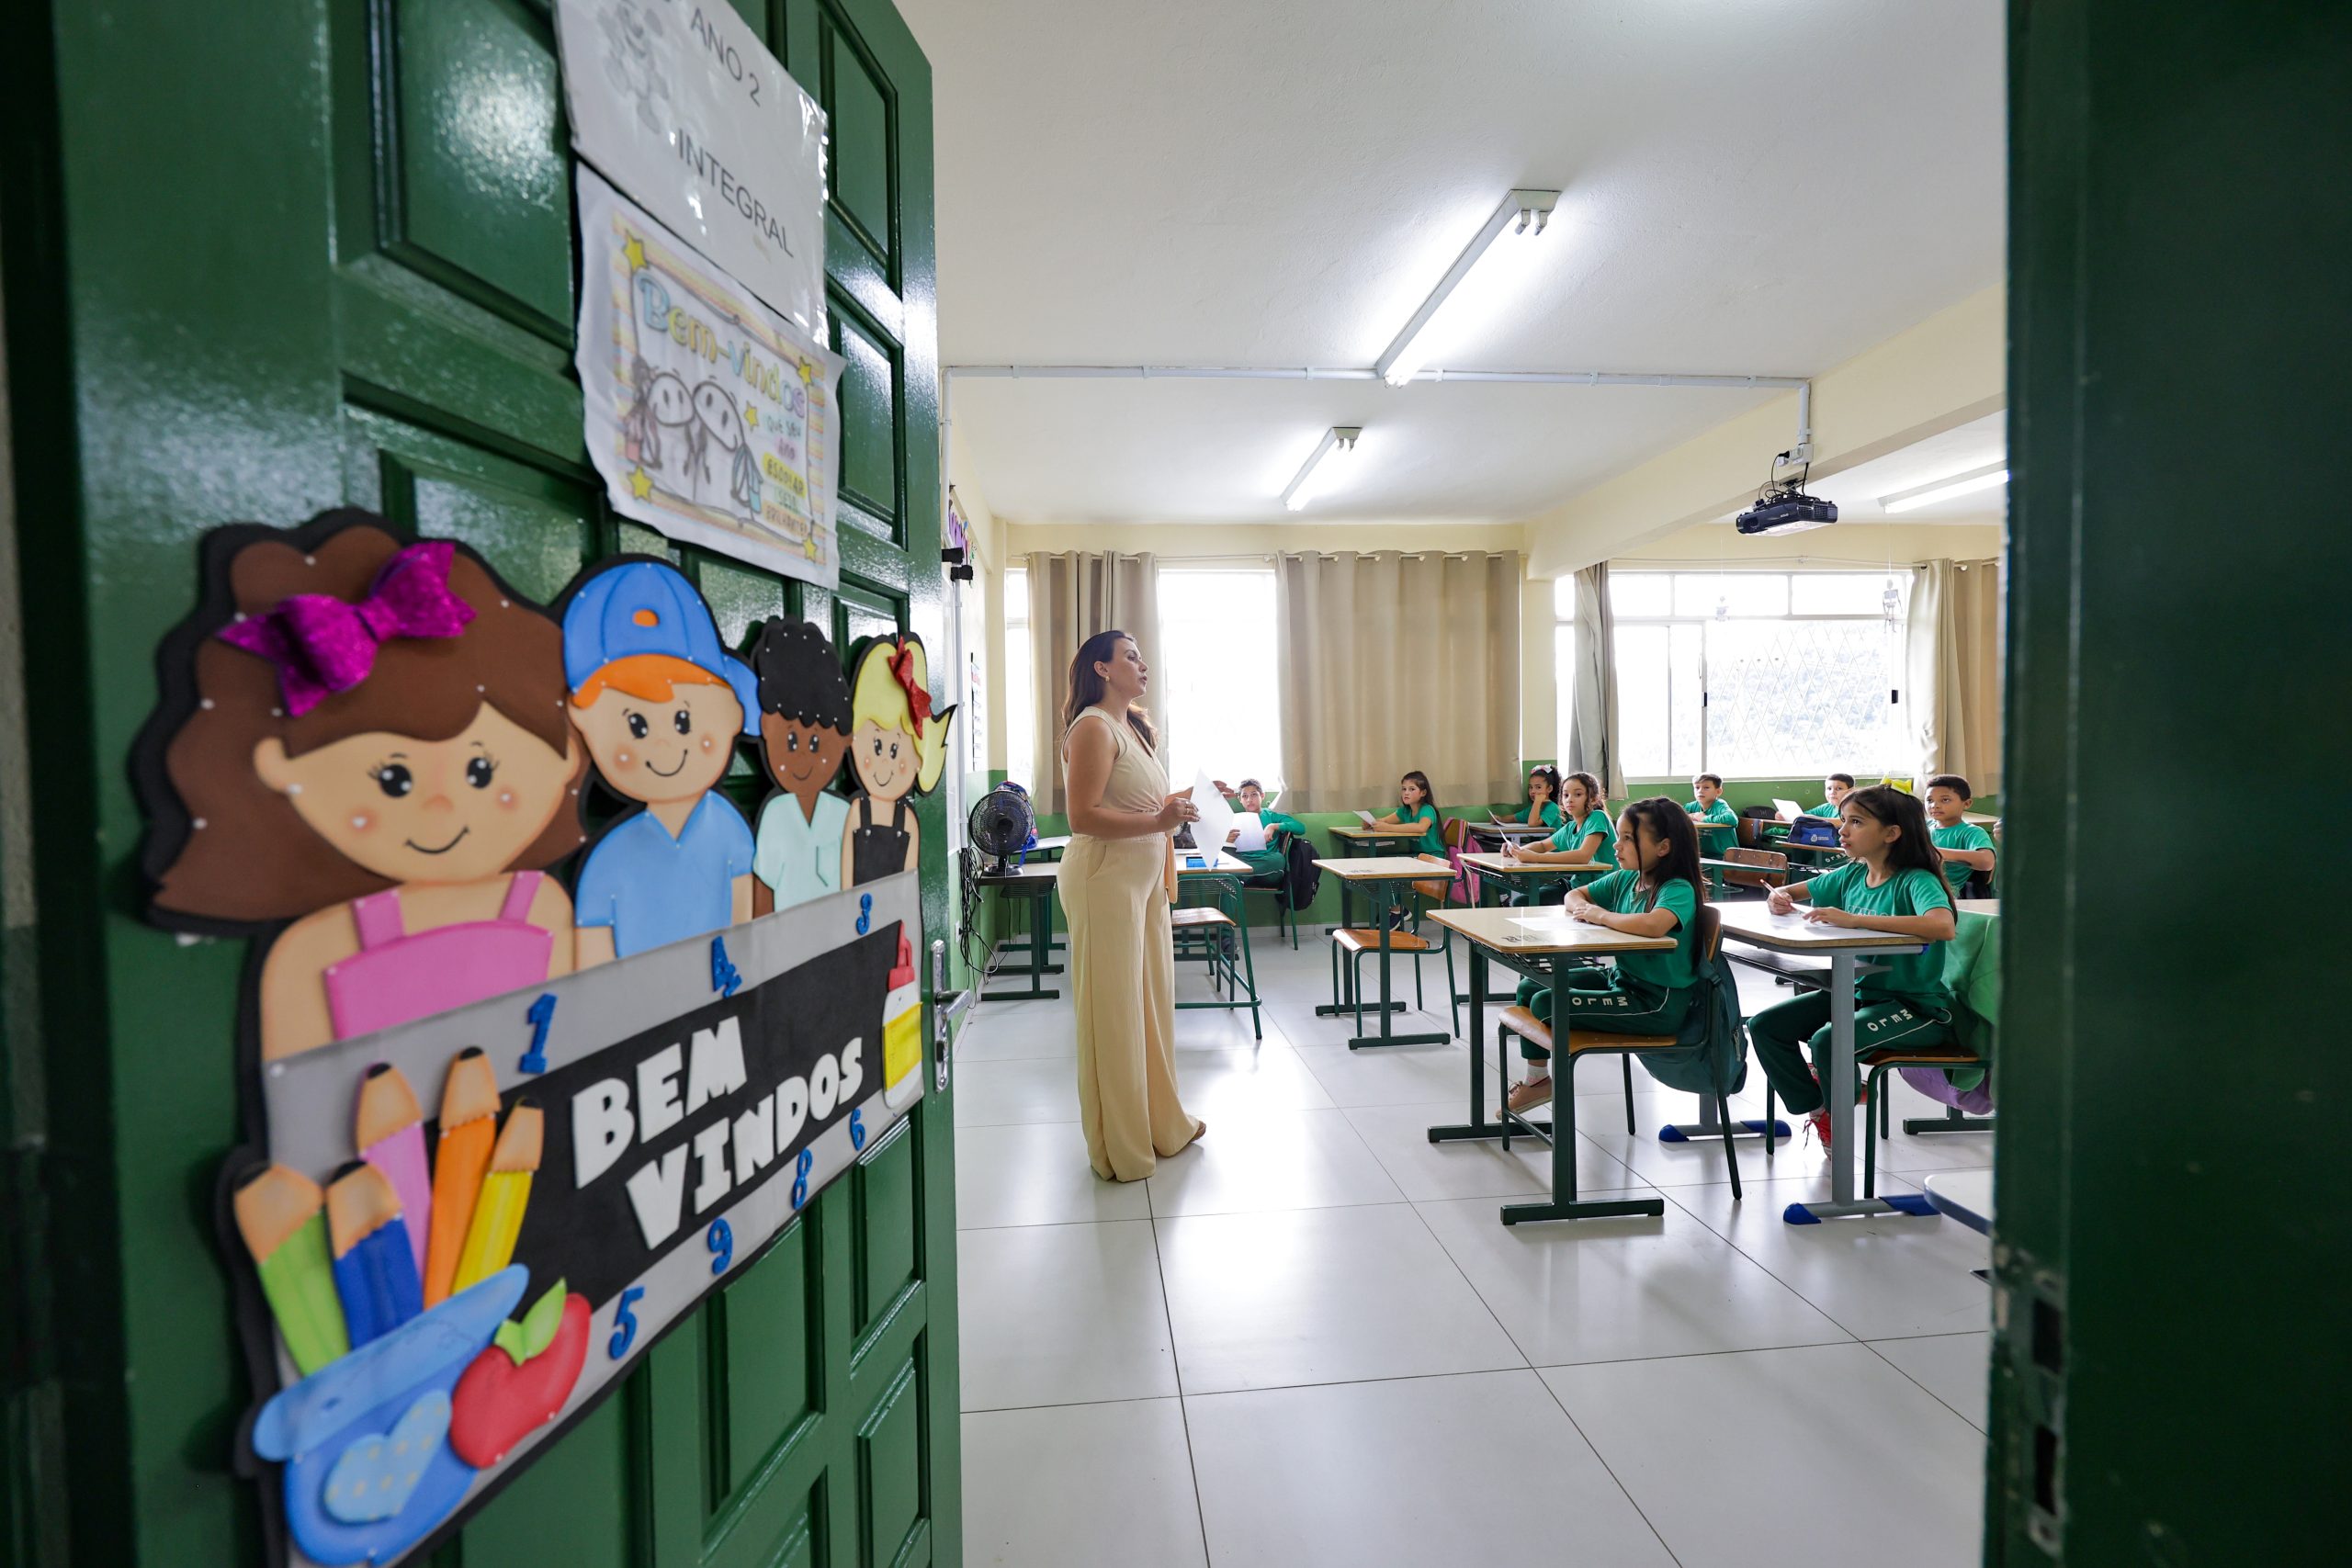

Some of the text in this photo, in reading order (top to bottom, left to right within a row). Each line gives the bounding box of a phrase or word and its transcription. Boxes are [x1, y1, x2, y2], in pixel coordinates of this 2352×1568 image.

[691, 6, 761, 107] ANO 2
[678, 128, 794, 259] INTEGRAL
[855, 893, 873, 936] 3
[710, 935, 741, 998] 4
[519, 993, 559, 1074] 1
[571, 1015, 747, 1190] BEM
[849, 1108, 865, 1152] 6
[626, 1036, 864, 1251] VINDOS
[792, 1147, 813, 1211] 8
[707, 1217, 733, 1276] 9
[608, 1286, 645, 1360] 5
